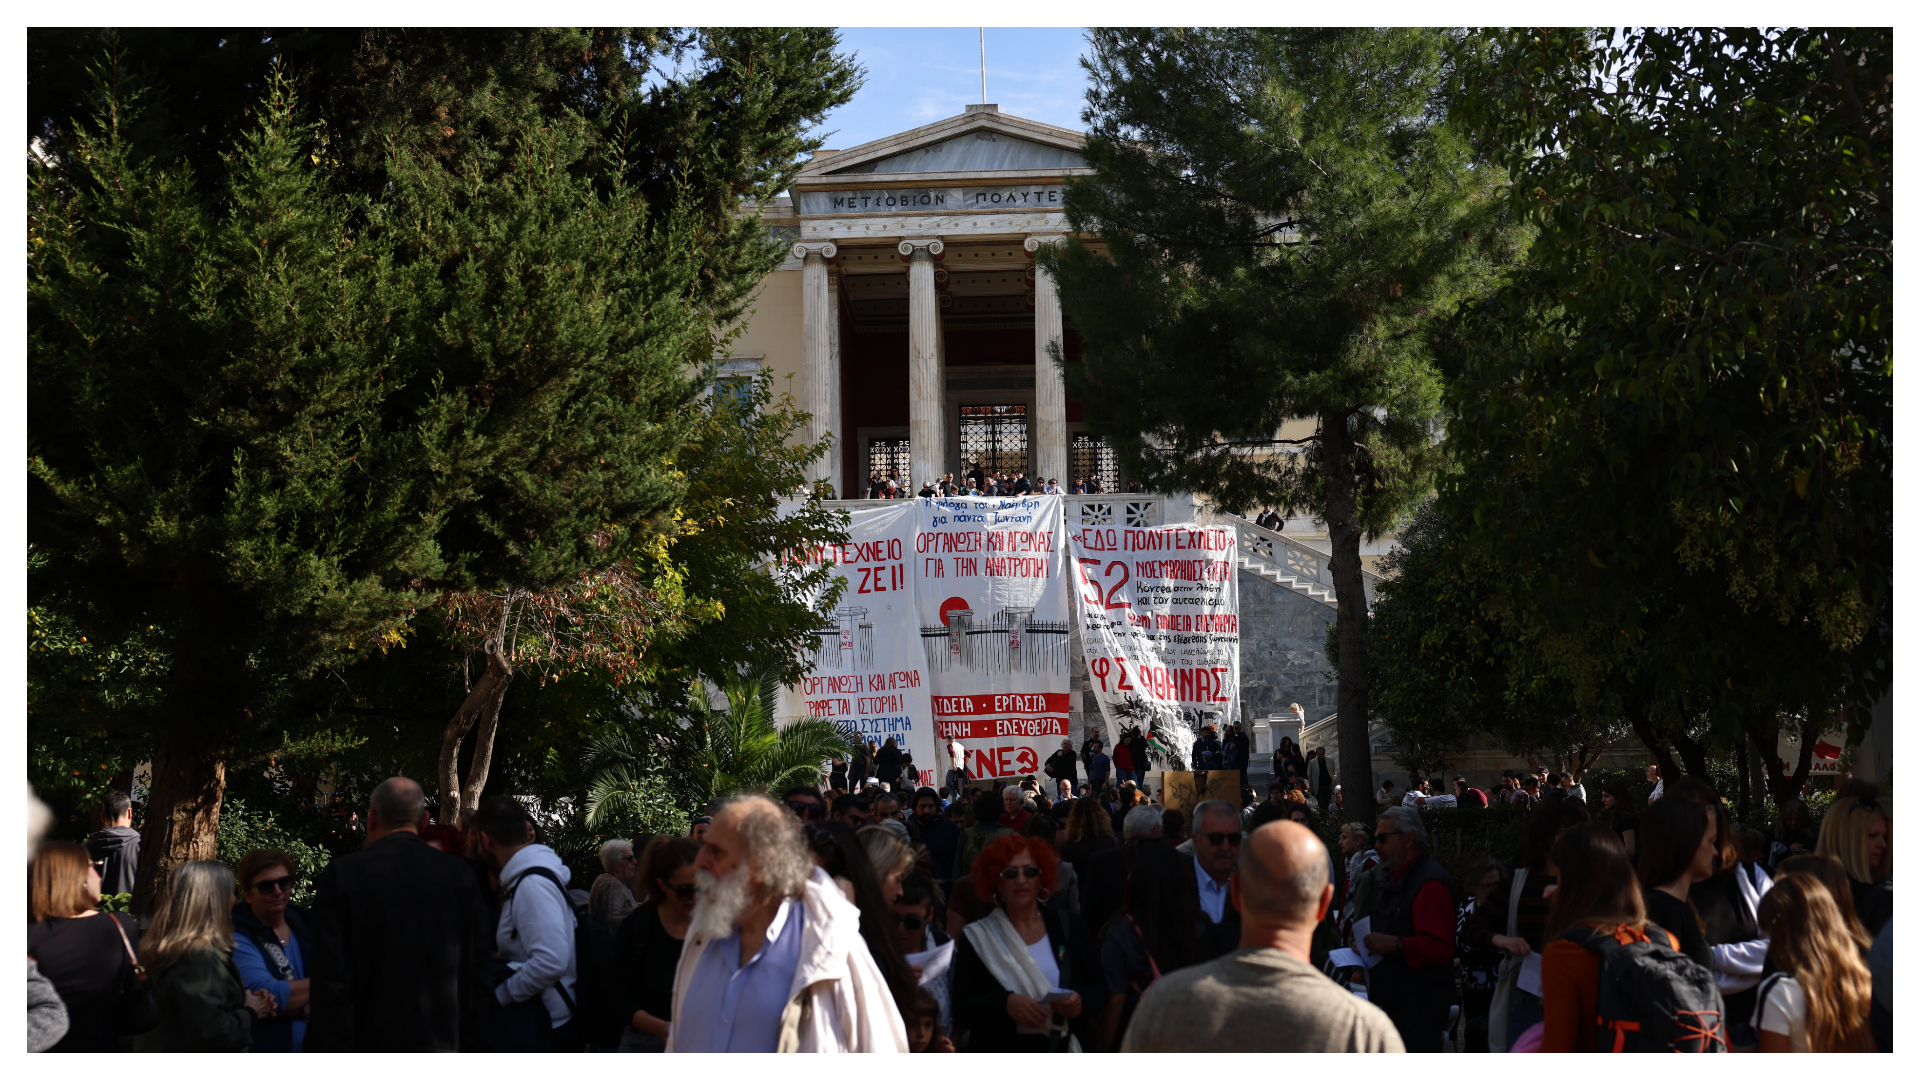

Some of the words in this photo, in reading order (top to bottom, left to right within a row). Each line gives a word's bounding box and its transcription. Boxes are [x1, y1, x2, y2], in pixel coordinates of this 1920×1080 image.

[833, 193, 945, 209] ΜΕΤΣΟΒΙΟΝ
[932, 515, 948, 528] για
[953, 511, 985, 523] πάντα
[994, 511, 1032, 524] ζωντανή
[916, 531, 982, 554] ΟΡΓΑΝΩΣΗ
[986, 531, 1004, 552] ΚΑΙ
[1007, 531, 1055, 553] ΑΓΩΝΑΣ
[857, 563, 904, 595] ΖΕΙ!
[925, 558, 945, 578] ΓΙΑ
[953, 557, 978, 578] ΤΗΝ
[984, 557, 1050, 579] ΑΝΑΤΡΟΠΗ!
[1078, 556, 1132, 610] 52
[1137, 596, 1151, 606] και
[803, 675, 864, 696] ΟΡΓΑΝΩΣΗ
[868, 673, 886, 693] ΚΑΙ
[888, 670, 921, 690] ΑΓΩΝΑ
[1139, 665, 1230, 702] ΑΘΗΝΑΣ
[994, 695, 1047, 712] ΕΡΓΑΣΙΑ
[860, 715, 912, 734] ΣΥΣΤΗΜΑ
